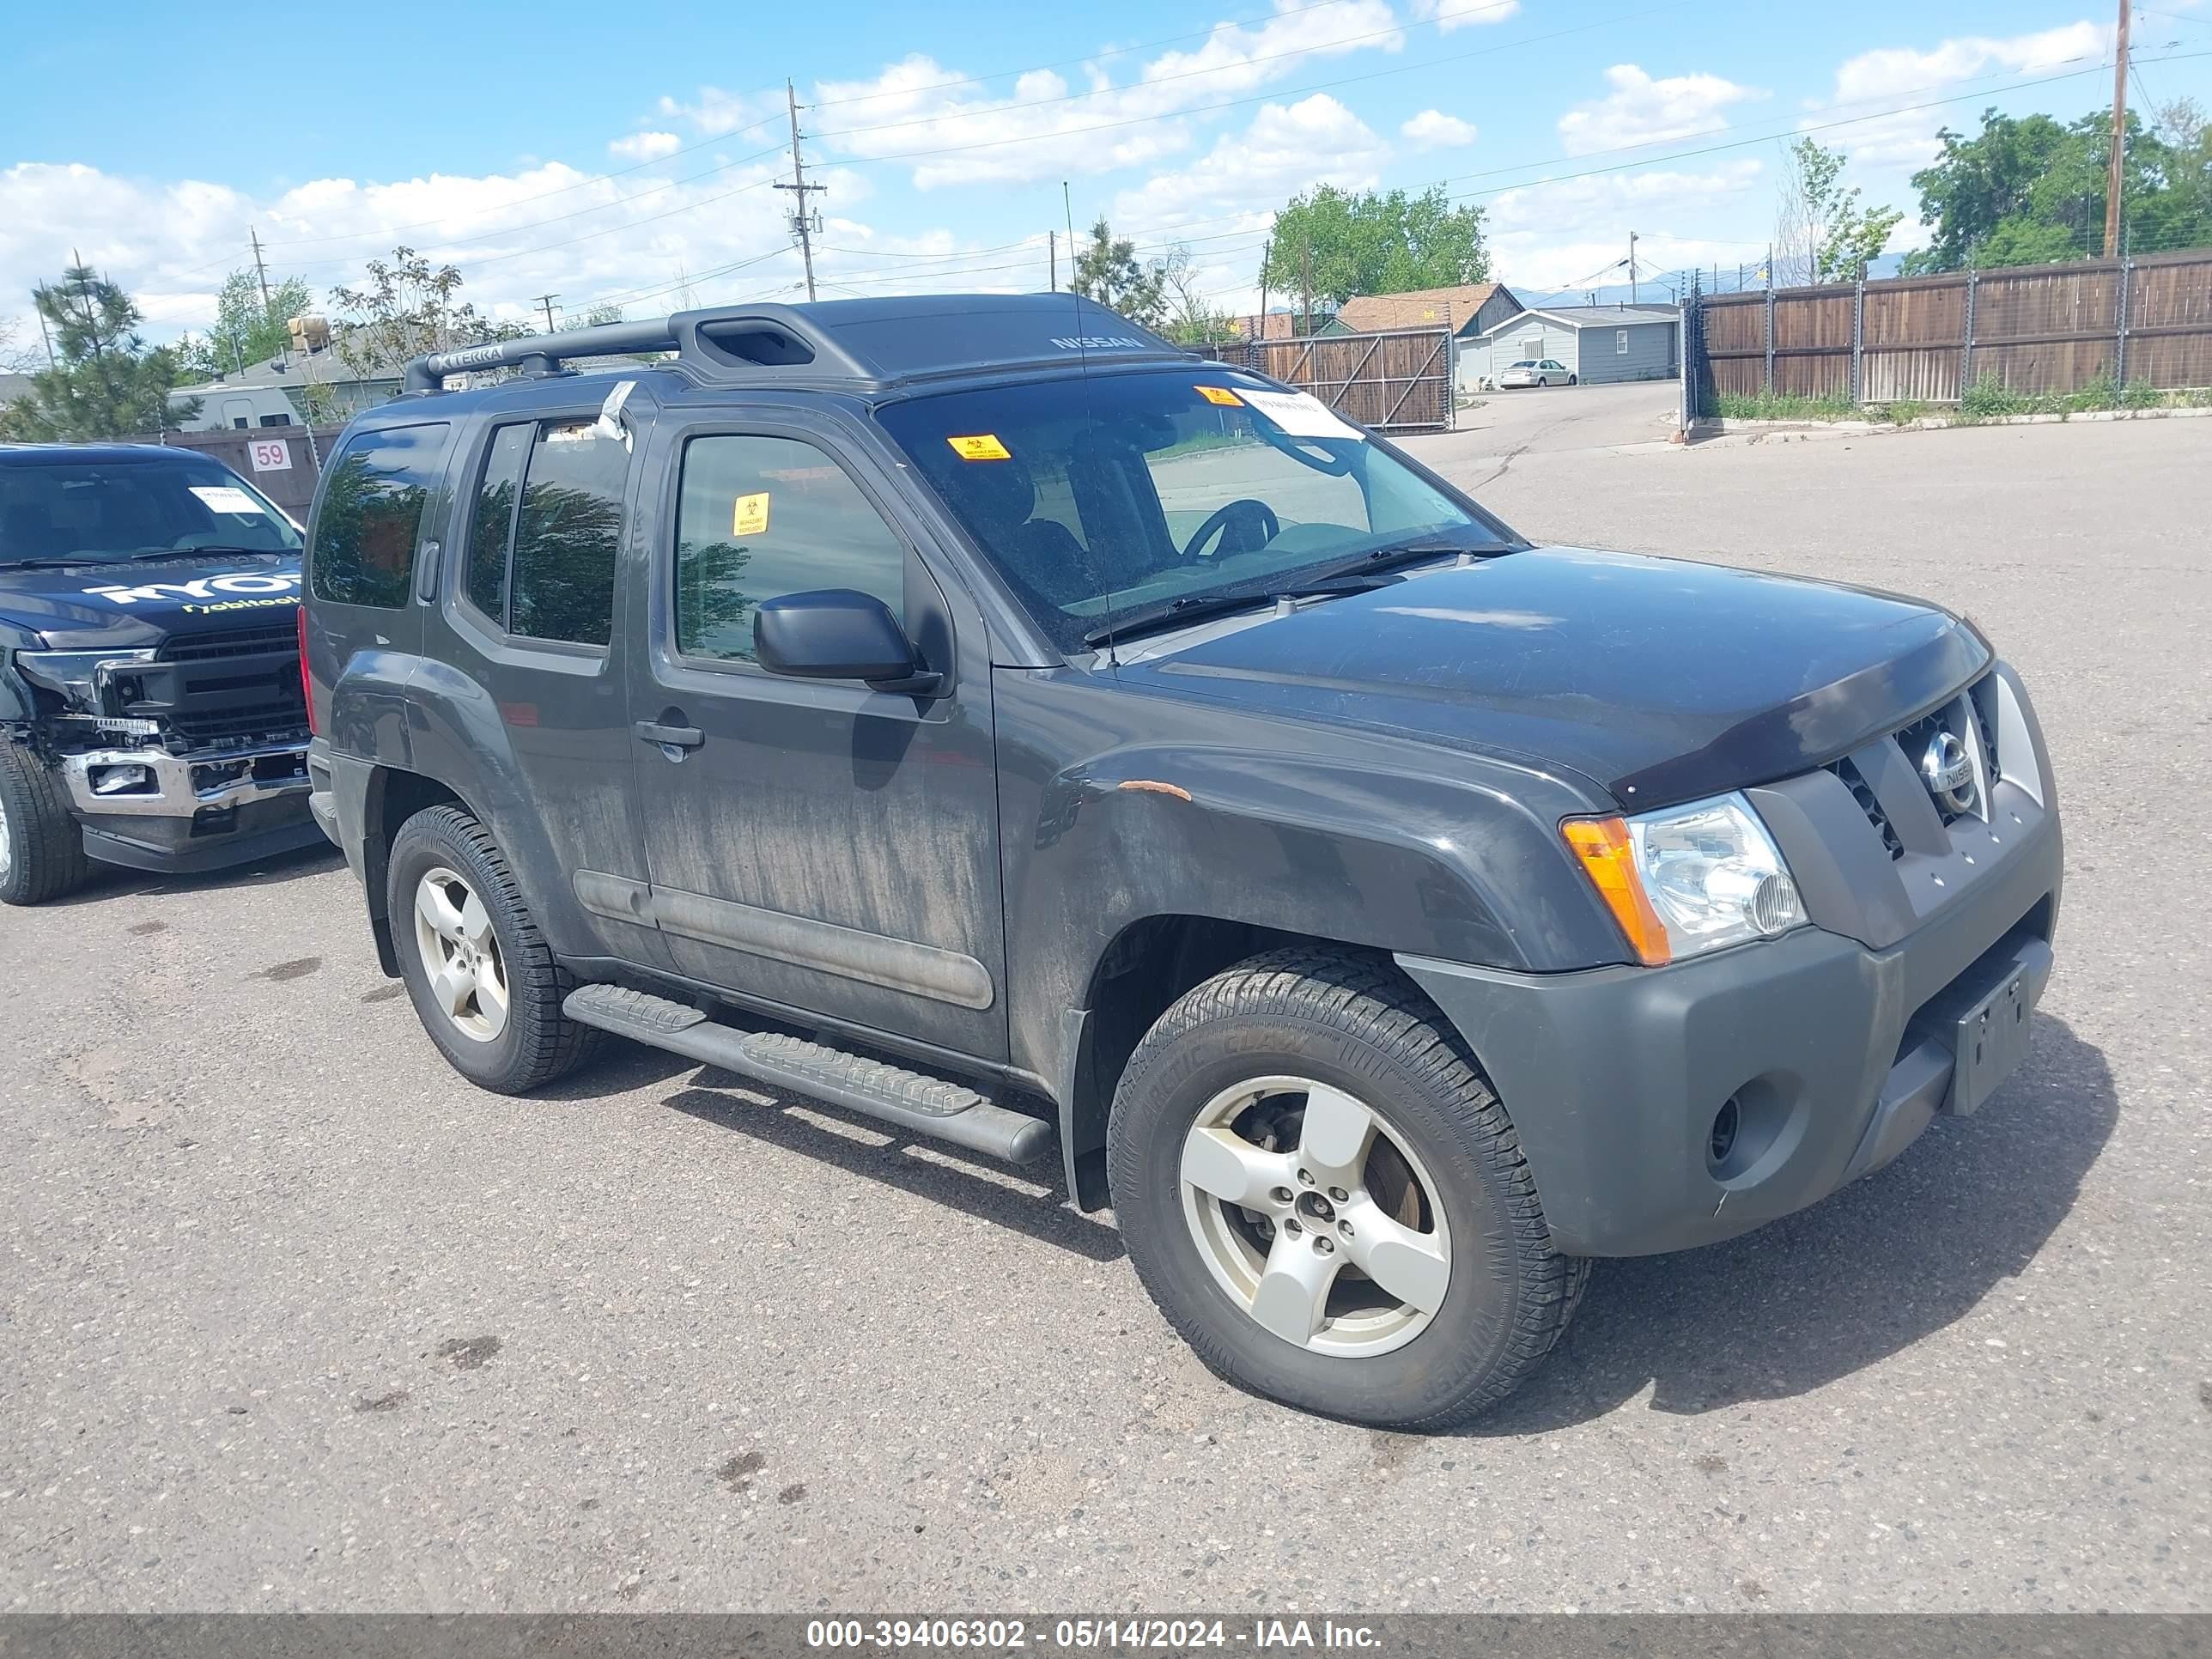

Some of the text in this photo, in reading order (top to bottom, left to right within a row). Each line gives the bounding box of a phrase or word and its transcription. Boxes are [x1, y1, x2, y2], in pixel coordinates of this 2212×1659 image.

[1049, 337, 1146, 350] NISSAN
[436, 344, 504, 371] XTERRA
[257, 444, 283, 466] 59
[82, 572, 301, 604] RYO
[181, 595, 301, 614] ryobitool
[1224, 1031, 1310, 1054] CLAW
